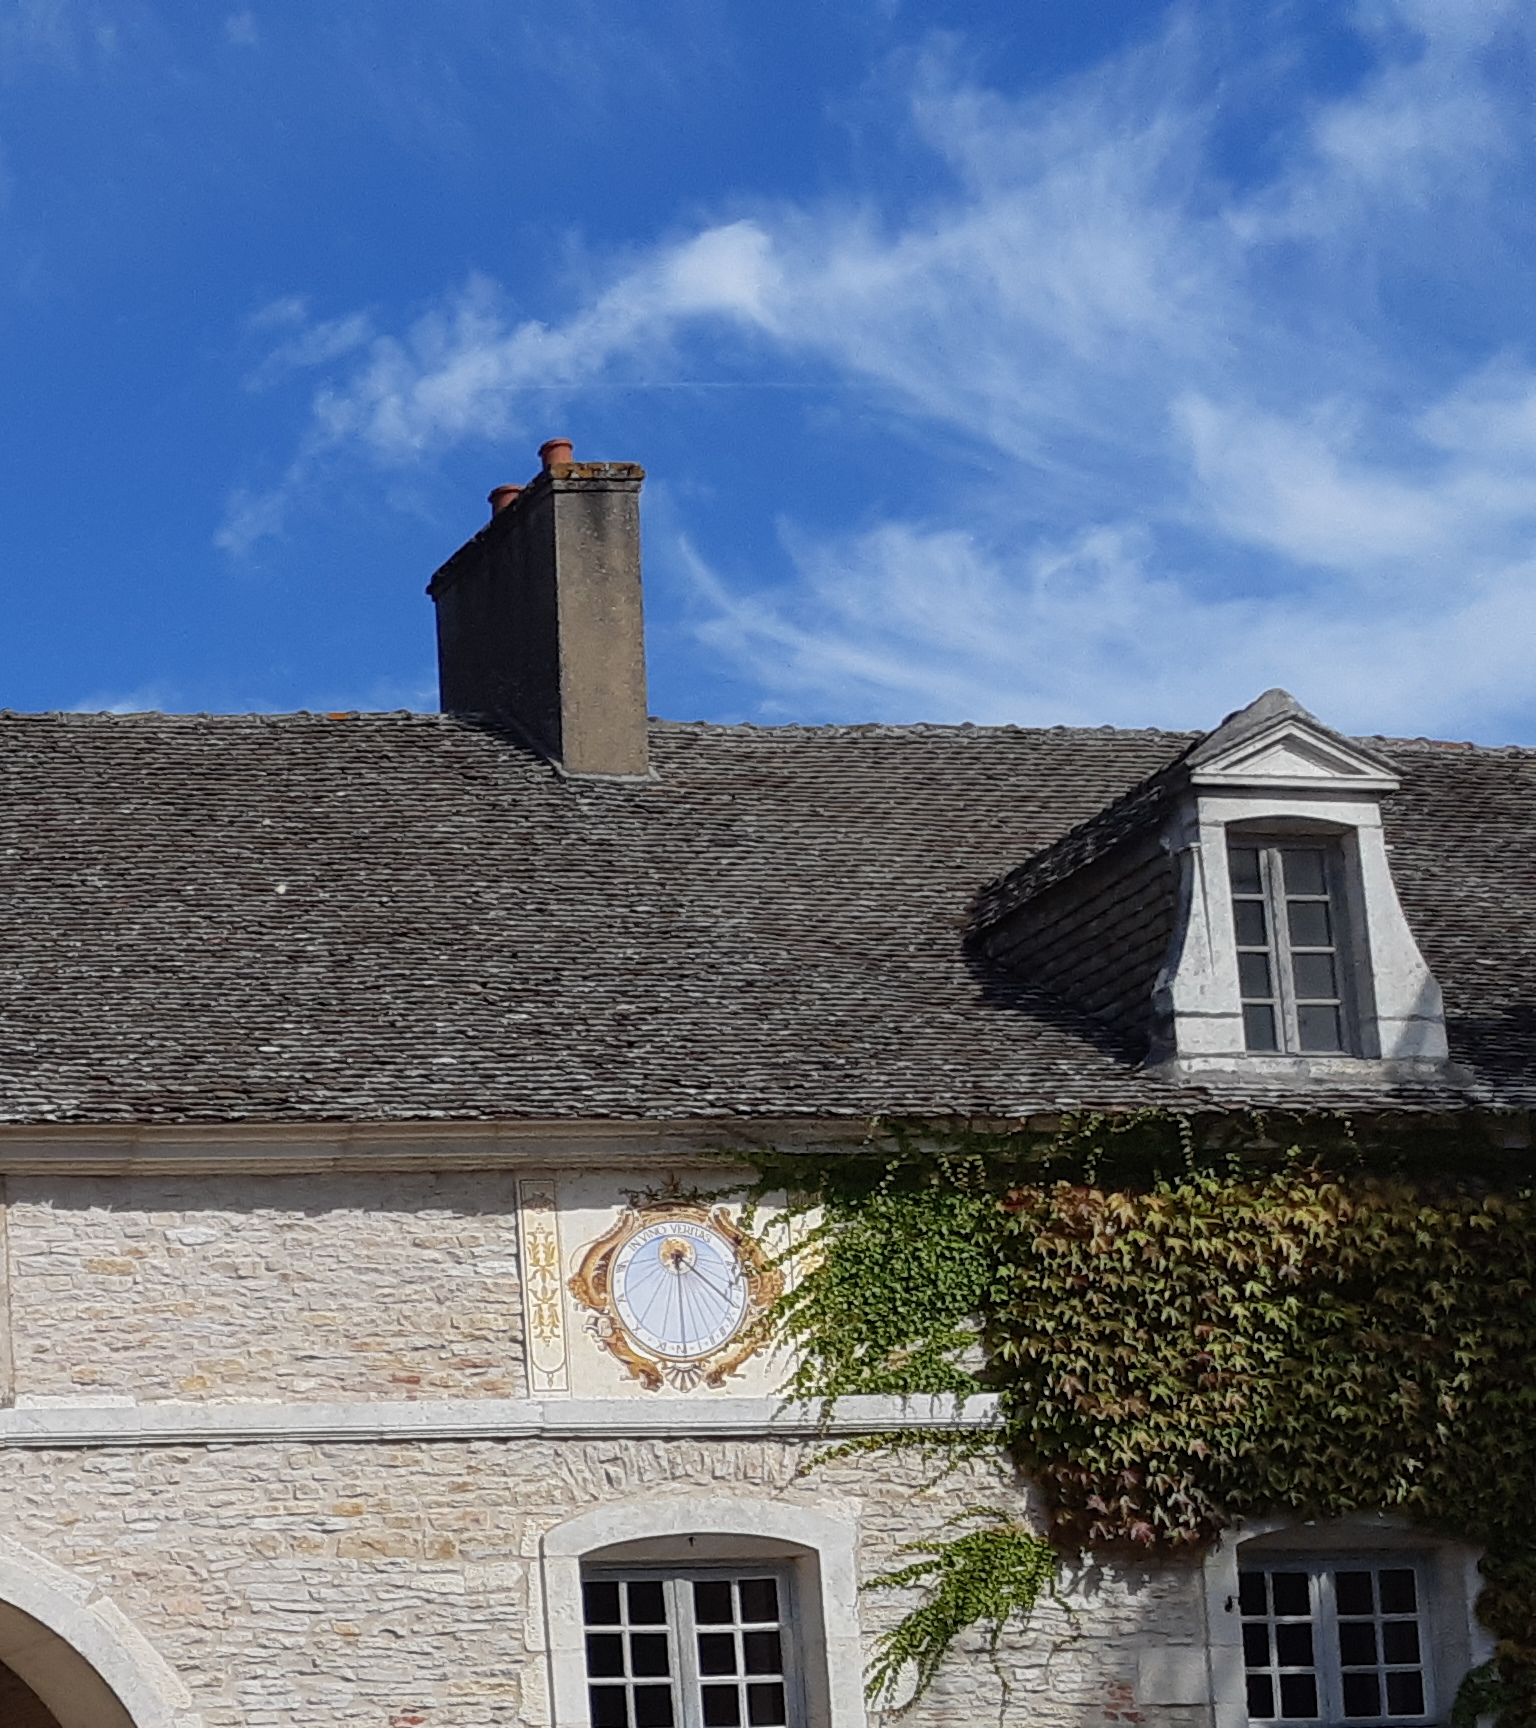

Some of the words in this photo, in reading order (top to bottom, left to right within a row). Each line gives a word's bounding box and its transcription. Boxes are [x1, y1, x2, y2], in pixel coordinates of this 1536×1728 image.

[628, 1239, 642, 1251] IN
[639, 1225, 666, 1243] VINO
[670, 1224, 712, 1243] VERITAS
